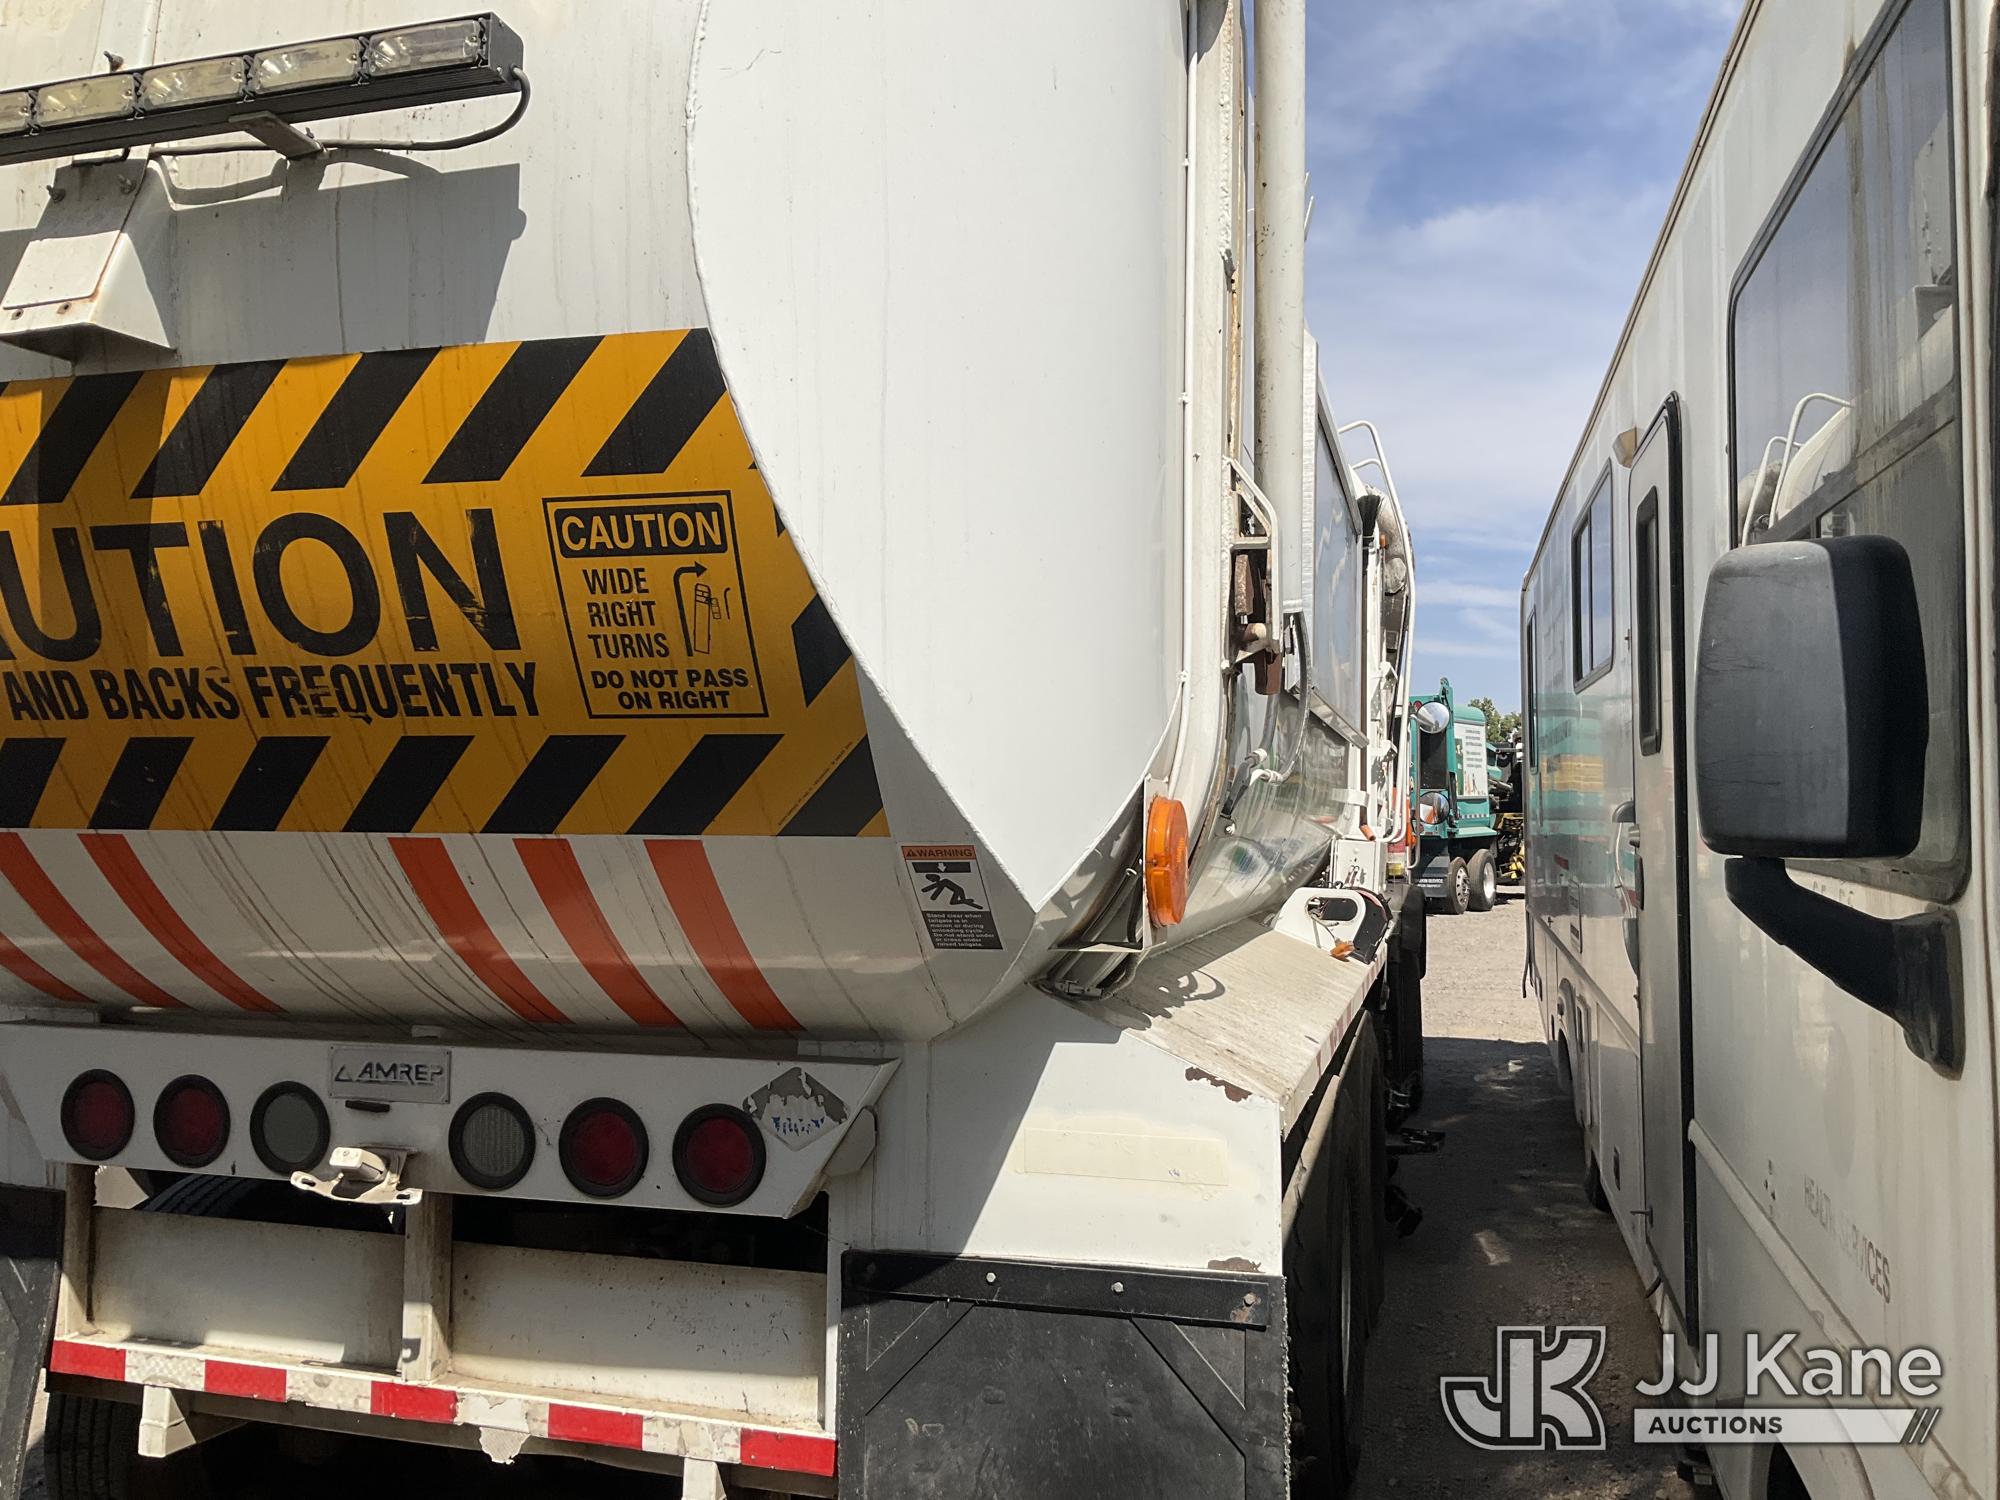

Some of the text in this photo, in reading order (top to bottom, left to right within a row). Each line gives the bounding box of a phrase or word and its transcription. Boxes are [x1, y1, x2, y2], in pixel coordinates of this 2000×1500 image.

[561, 511, 722, 551] CAUTION
[0, 508, 522, 662] UTION
[582, 567, 649, 595] WIDE
[587, 600, 656, 628] RIGHT
[587, 632, 670, 659] TURNS
[591, 668, 749, 689] DO NOT PASS
[3, 661, 540, 726] AND BACKS FREQUENTLY
[617, 690, 731, 710] ON RIGHT
[917, 848, 972, 858] WARNING
